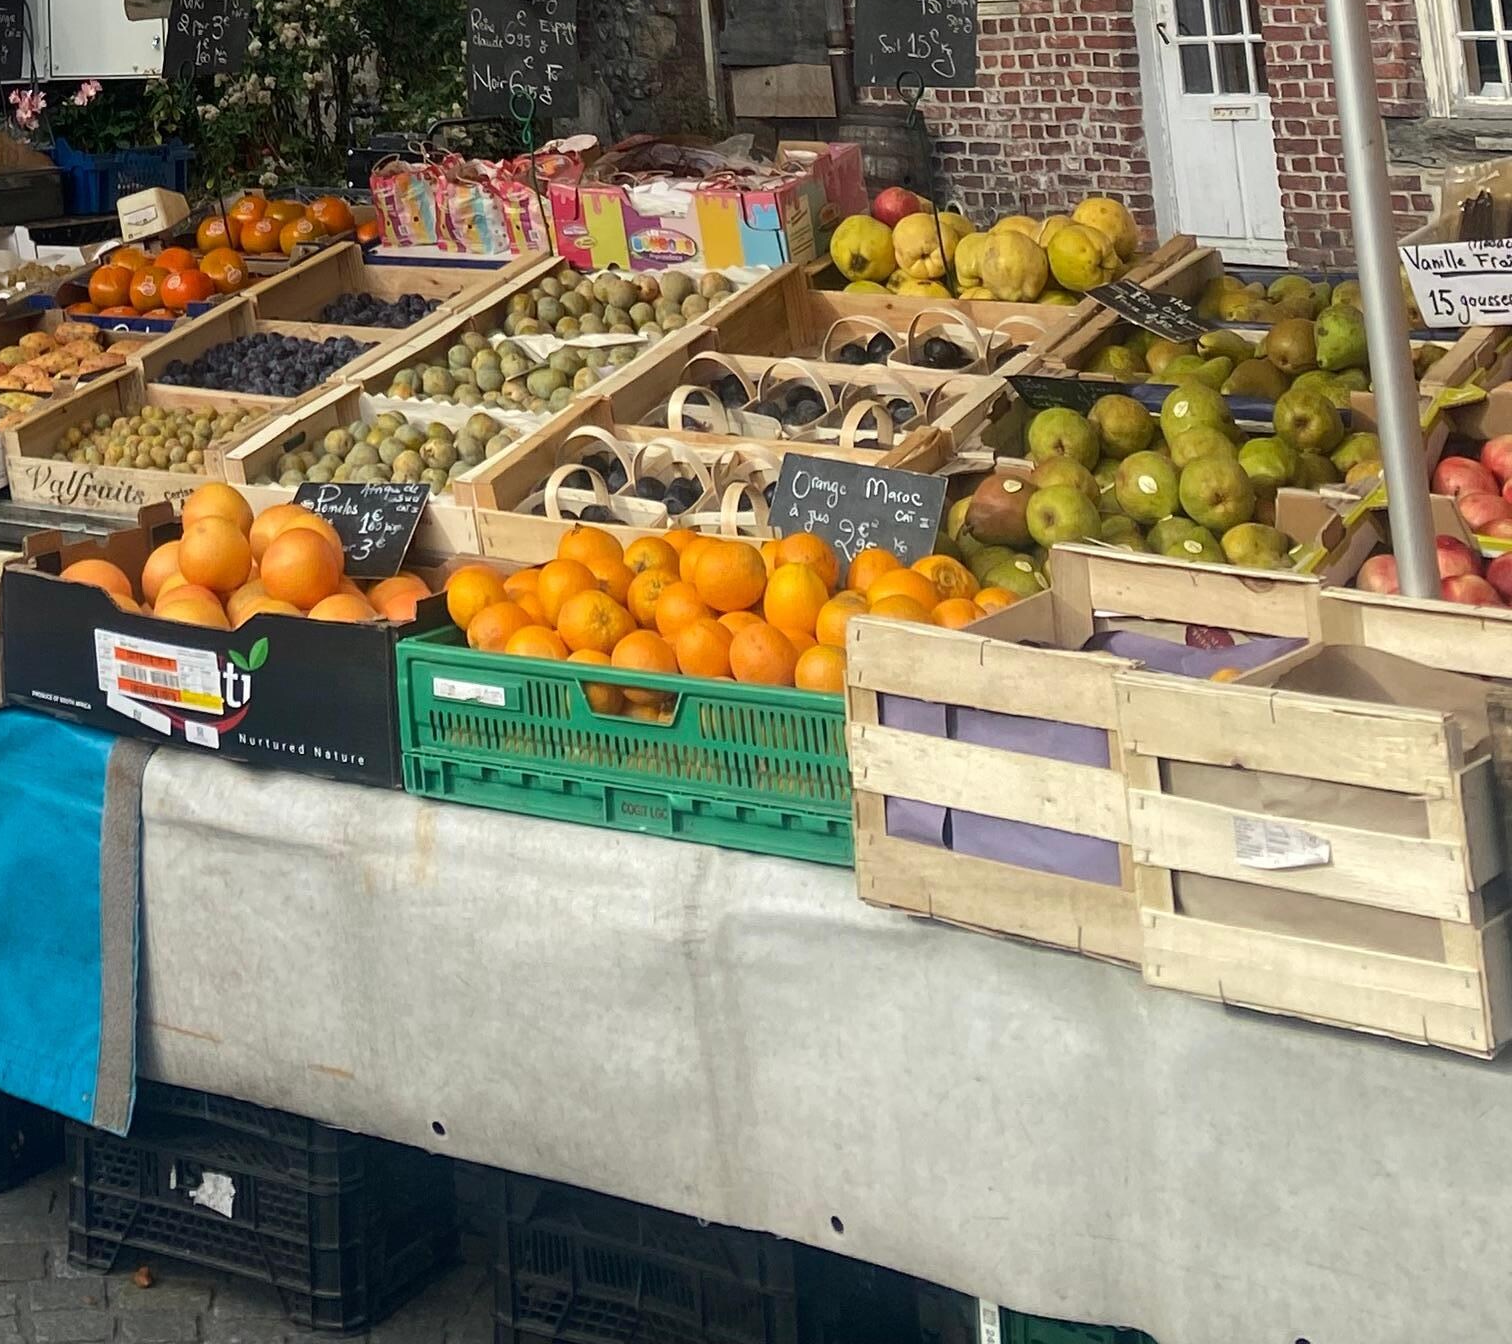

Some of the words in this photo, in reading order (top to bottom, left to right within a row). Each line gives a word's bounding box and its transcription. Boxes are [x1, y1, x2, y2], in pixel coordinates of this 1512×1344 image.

[1403, 245, 1466, 270] Vanille
[1428, 289, 1455, 316] 15
[25, 464, 146, 506] Valfruits
[792, 470, 848, 509] Orange
[865, 477, 924, 507] Maroc
[804, 509, 831, 534] jus
[238, 732, 306, 755] Nurtured
[313, 746, 366, 766] Nature
